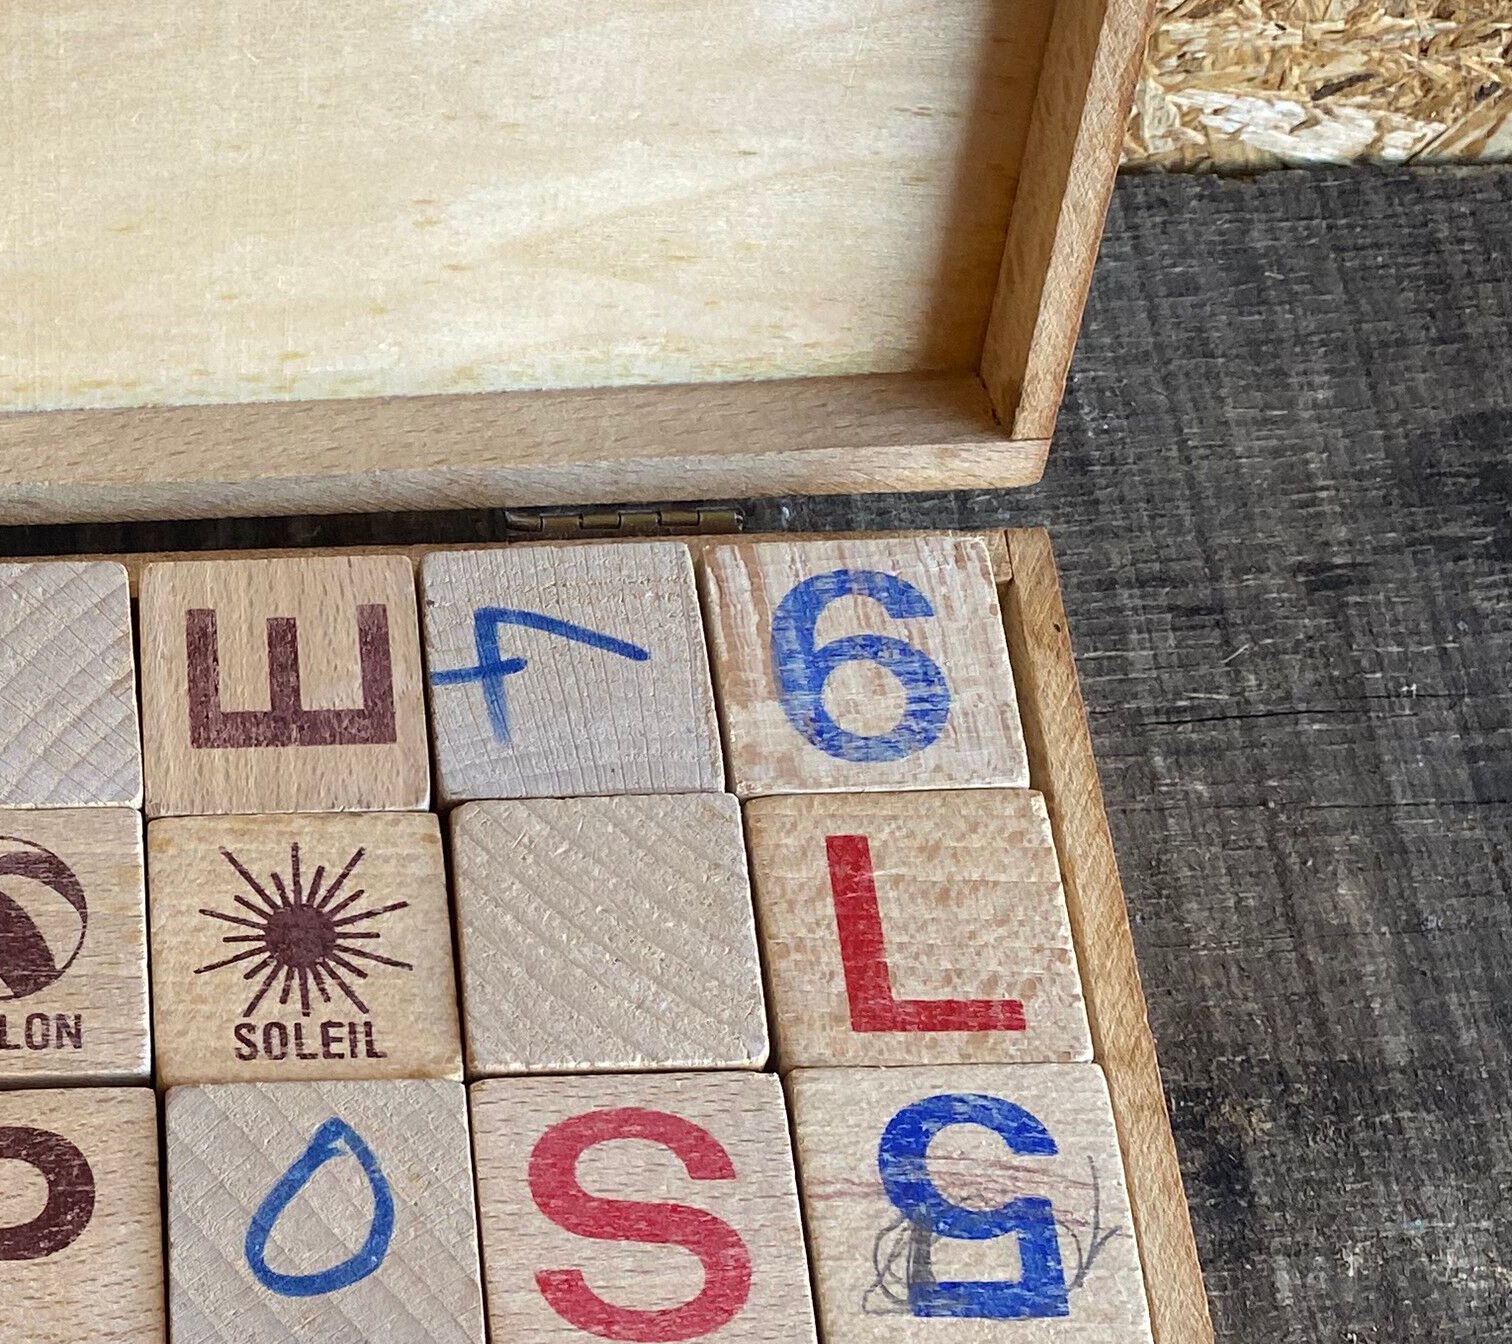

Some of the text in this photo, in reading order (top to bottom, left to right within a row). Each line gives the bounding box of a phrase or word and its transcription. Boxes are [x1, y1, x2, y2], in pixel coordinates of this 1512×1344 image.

[186, 603, 397, 749] E
[826, 835, 1027, 1032] L
[234, 1020, 387, 1063] SOLEIL
[528, 1107, 752, 1343] S
